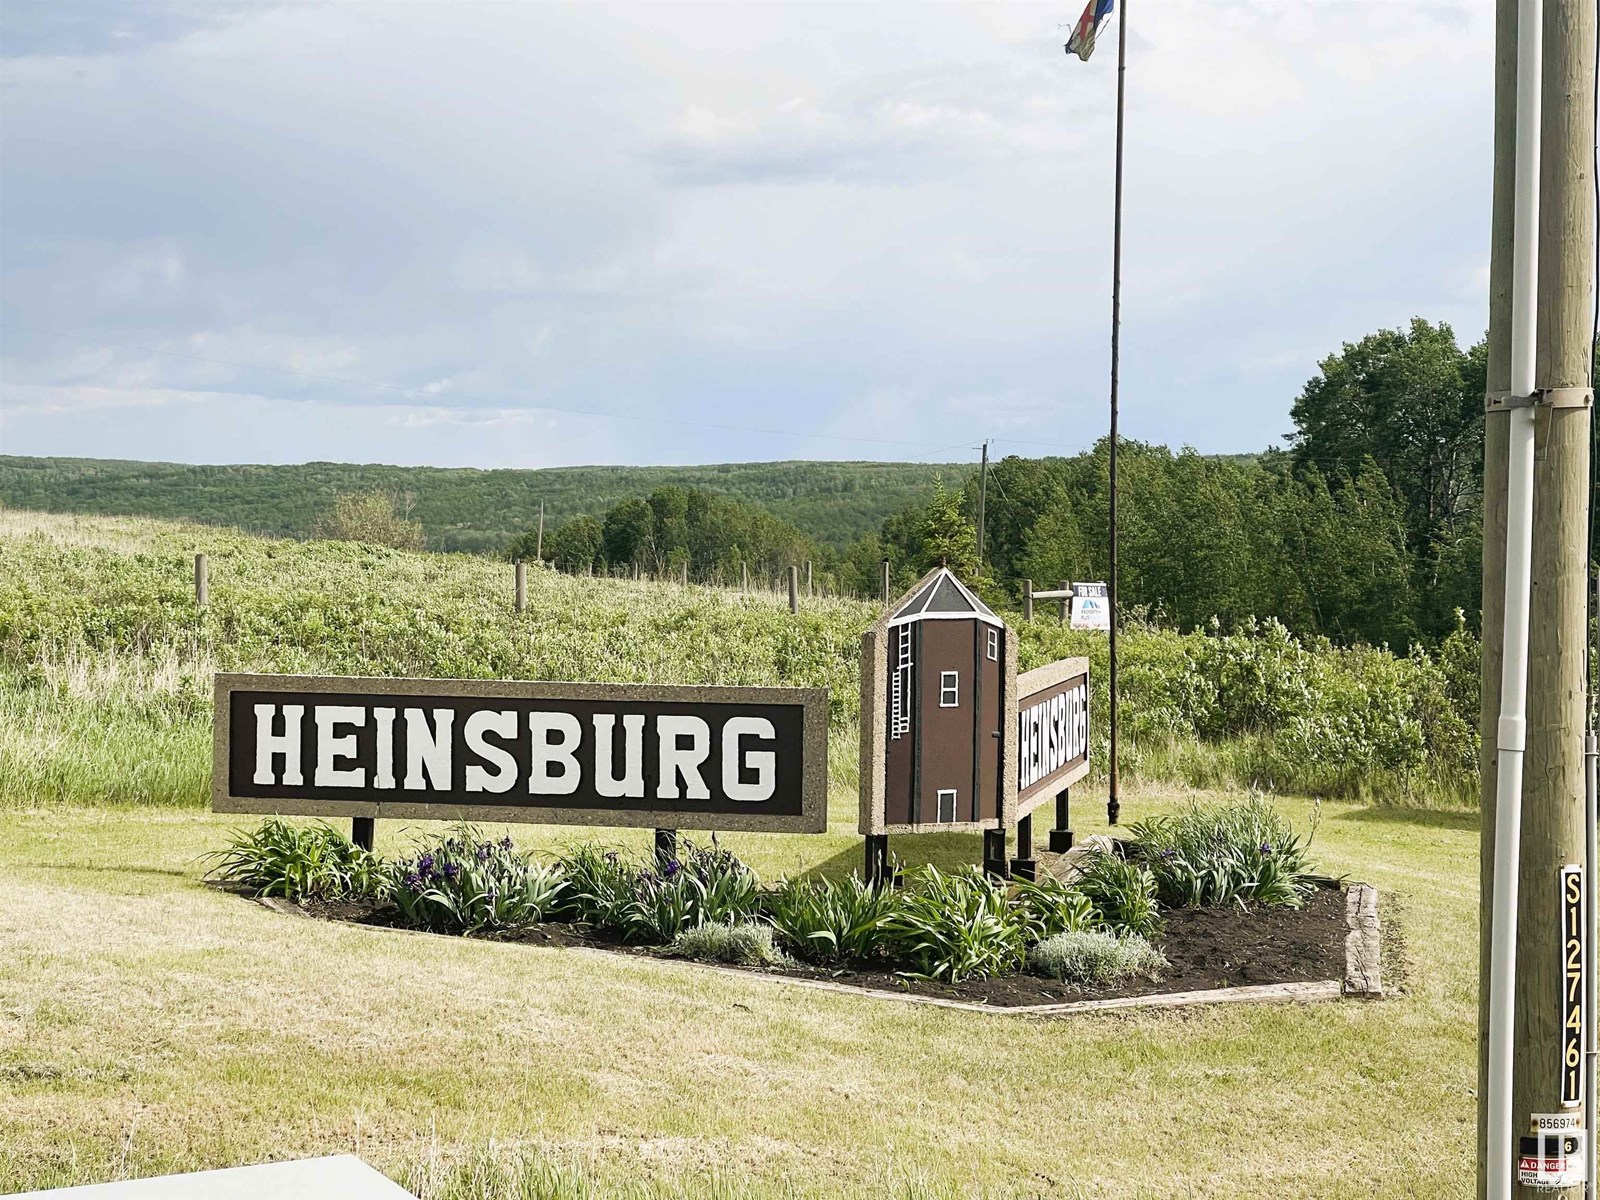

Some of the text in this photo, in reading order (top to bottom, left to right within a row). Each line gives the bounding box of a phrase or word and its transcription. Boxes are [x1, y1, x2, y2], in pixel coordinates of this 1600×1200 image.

[1078, 586, 1102, 597] FOR SALE
[1020, 684, 1086, 791] HEINSBURG
[253, 704, 777, 802] HEINSBURG
[1565, 873, 1581, 1100] S127461
[1539, 1118, 1575, 1129] 856974
[1564, 1141, 1573, 1152] 6
[1530, 1162, 1566, 1170] DANGER
